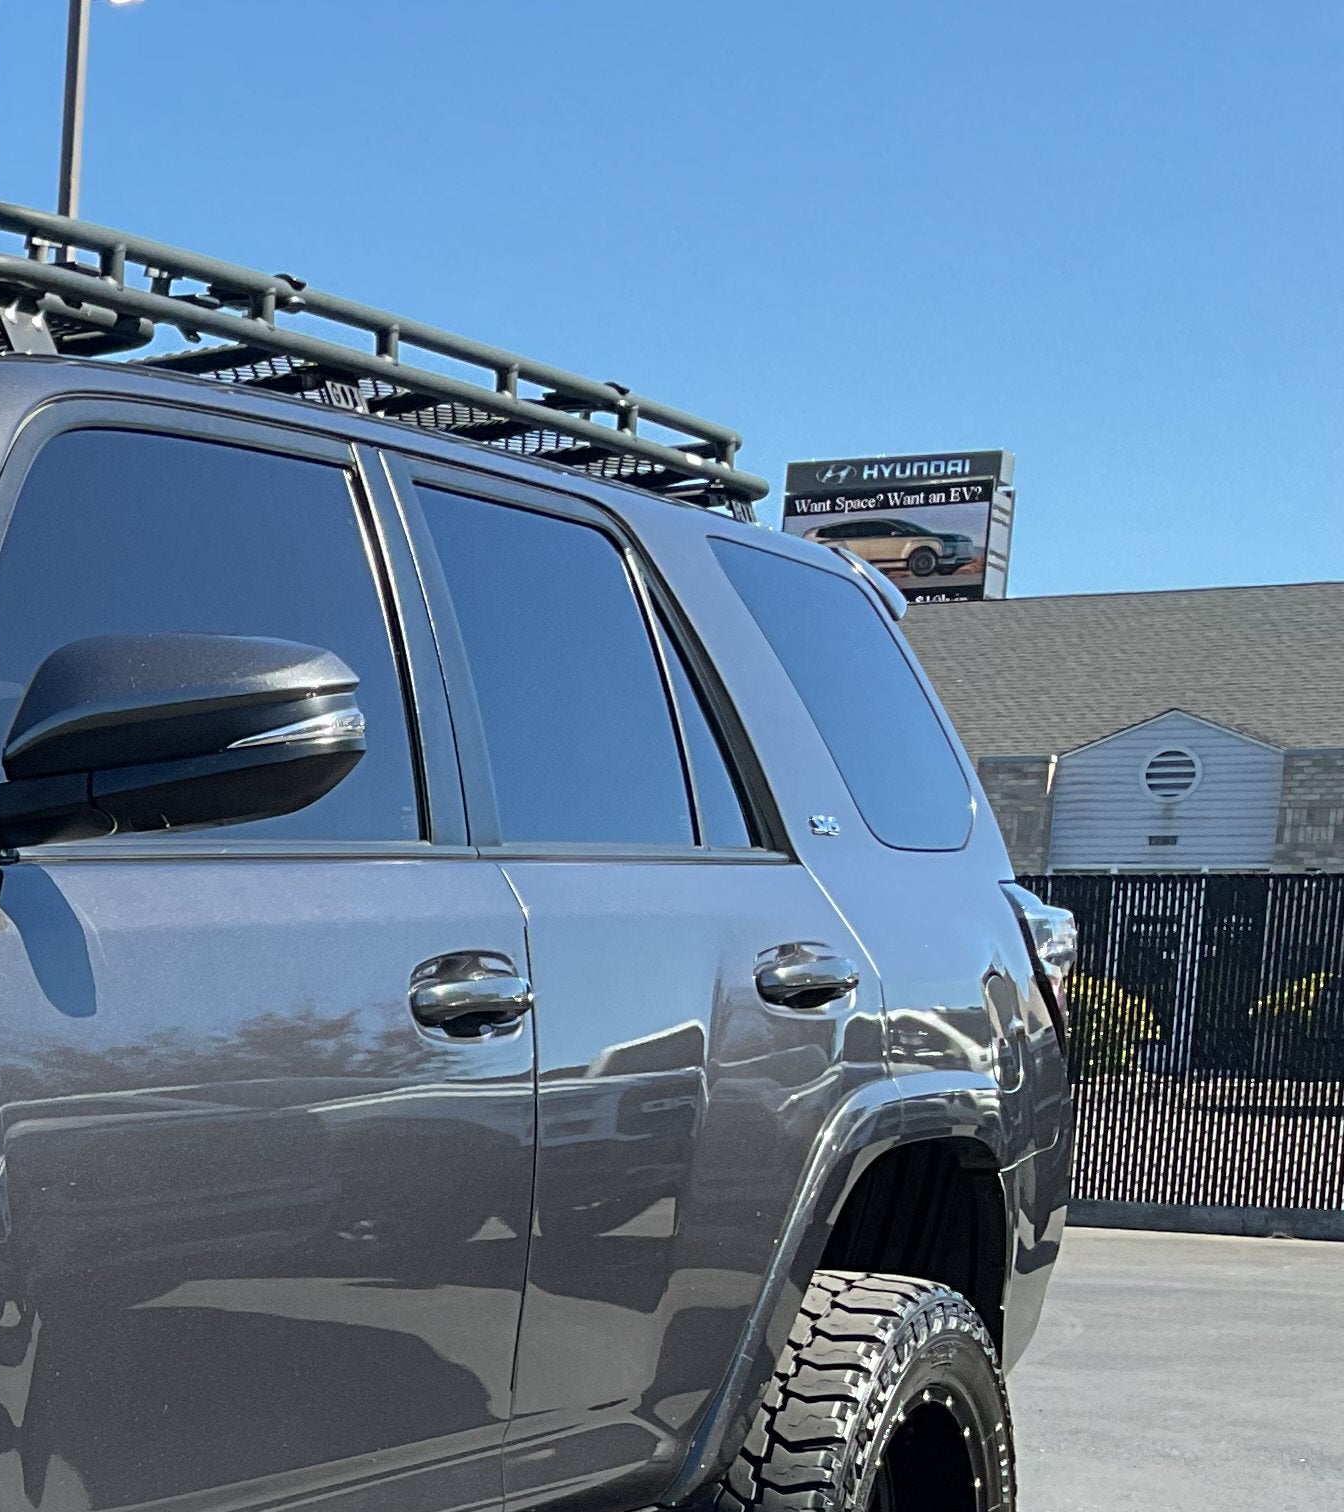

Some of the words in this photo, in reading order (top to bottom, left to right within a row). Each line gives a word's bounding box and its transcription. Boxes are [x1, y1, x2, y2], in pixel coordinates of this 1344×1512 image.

[863, 459, 970, 480] HYUNDAI
[795, 498, 831, 514] Want
[835, 493, 884, 513] Space?
[887, 490, 925, 507] Want
[928, 492, 946, 504] an
[949, 485, 983, 502] EV?
